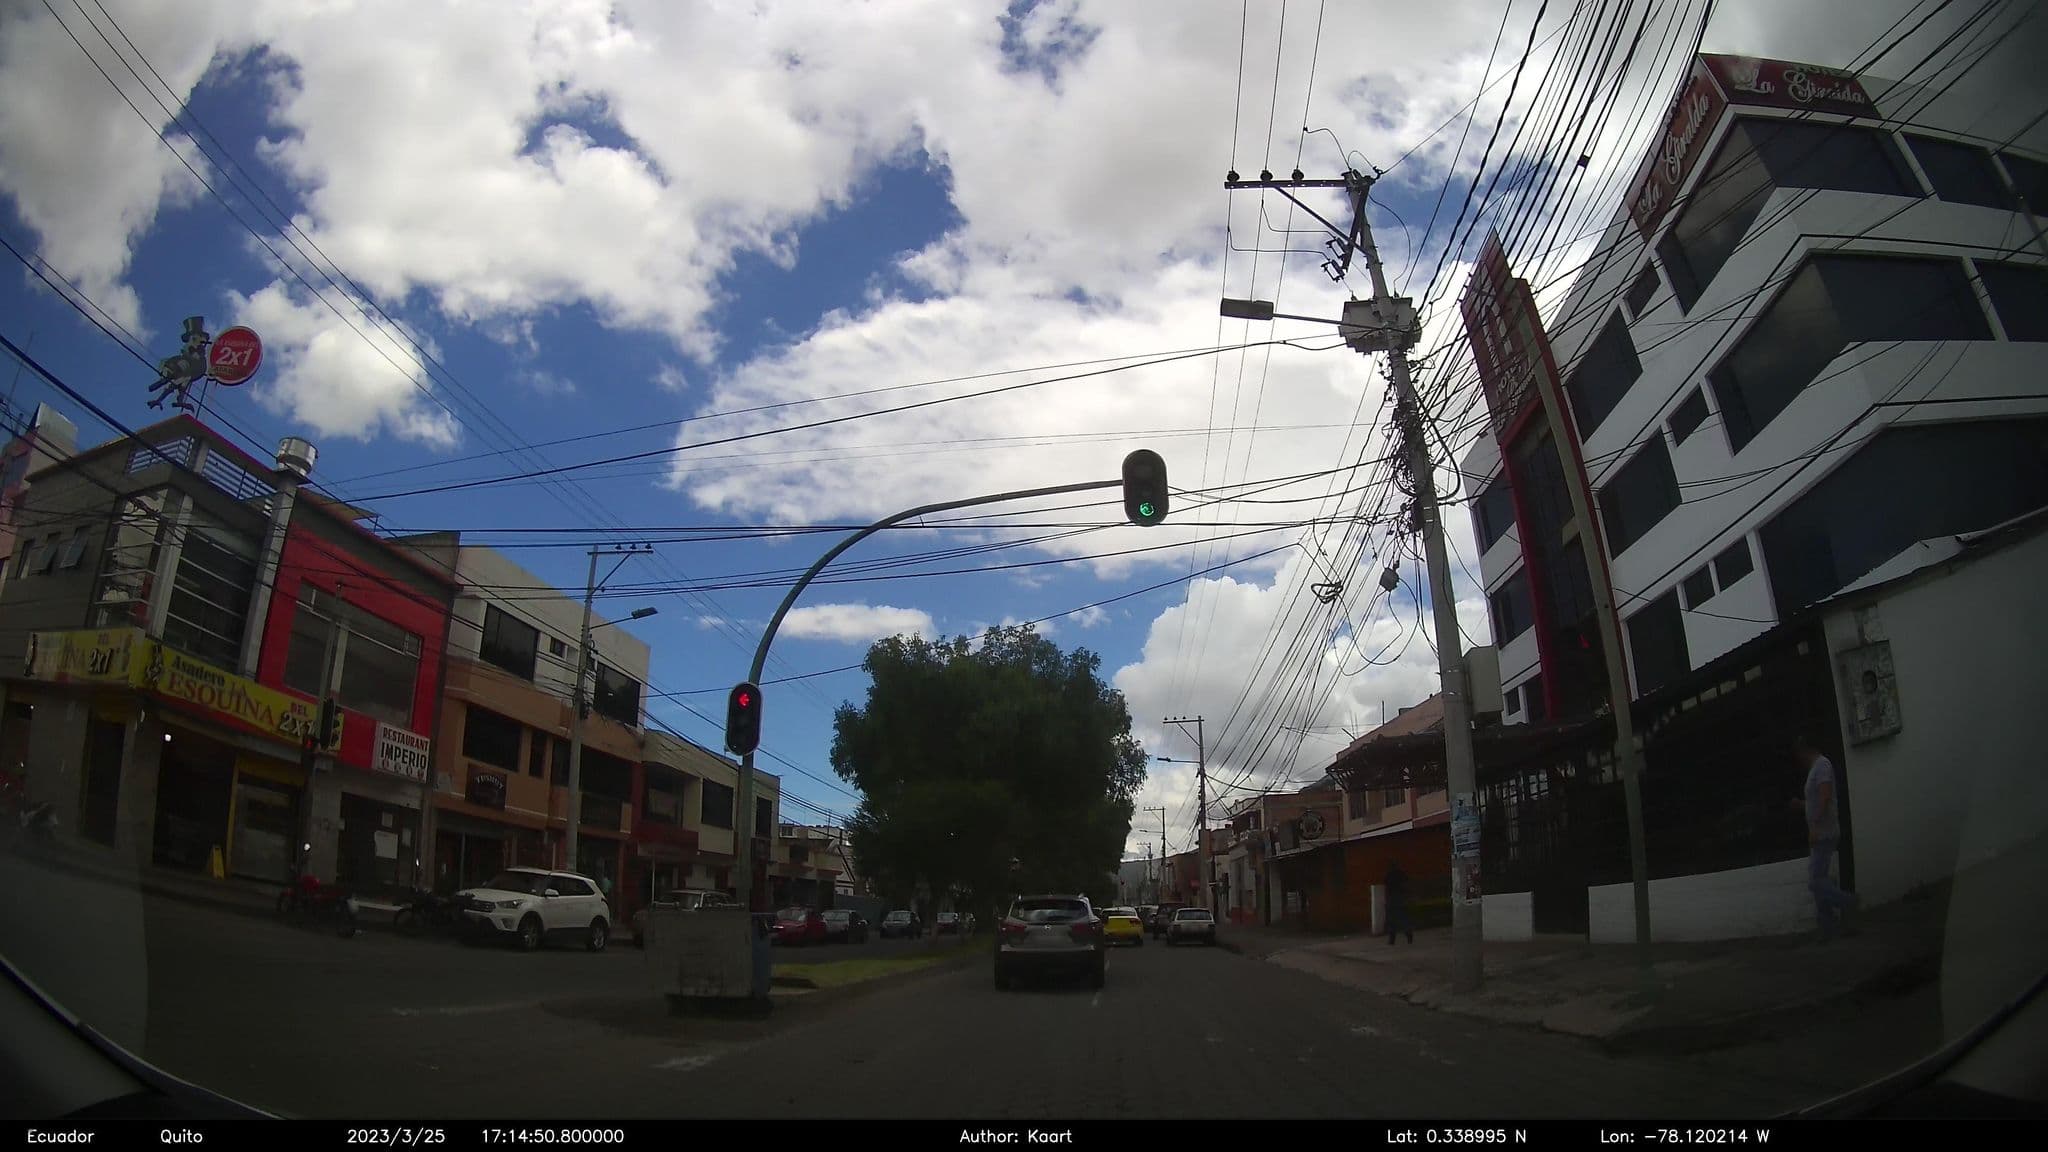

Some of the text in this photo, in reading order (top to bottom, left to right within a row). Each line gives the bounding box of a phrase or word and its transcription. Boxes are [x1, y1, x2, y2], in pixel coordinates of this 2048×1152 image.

[1734, 68, 1776, 95] La
[173, 655, 226, 687] Asadero
[167, 671, 276, 728] ESQUINA
[382, 726, 429, 752] RESTAURANT
[380, 741, 427, 770] IMPERIO
